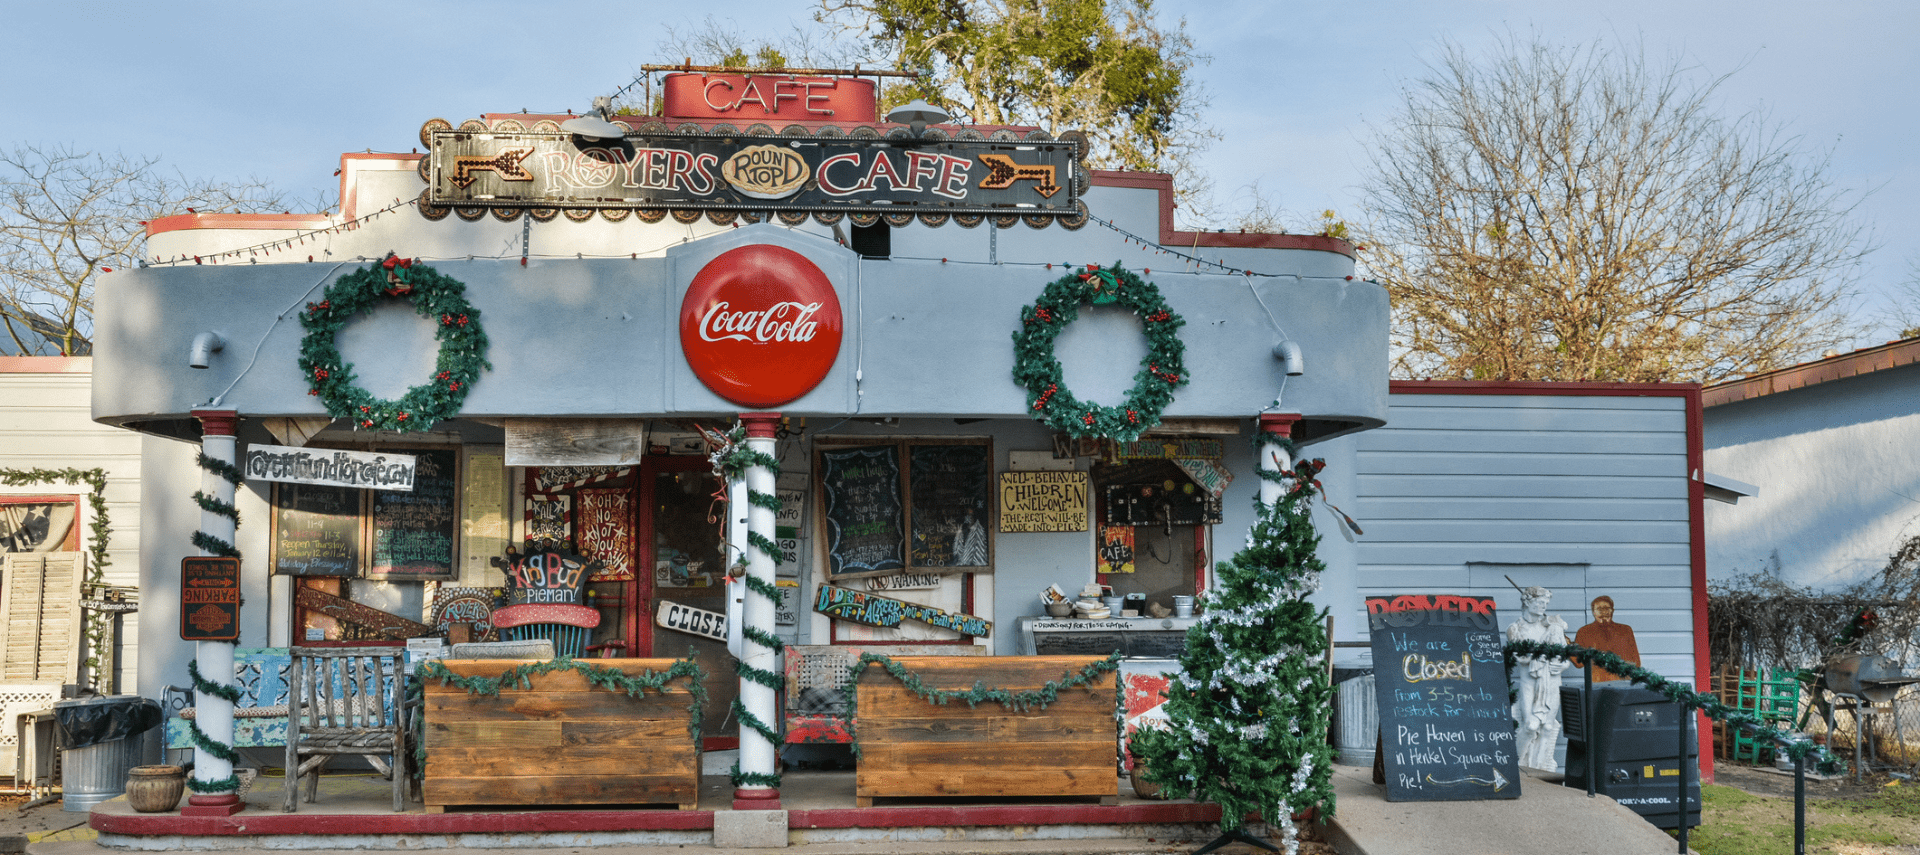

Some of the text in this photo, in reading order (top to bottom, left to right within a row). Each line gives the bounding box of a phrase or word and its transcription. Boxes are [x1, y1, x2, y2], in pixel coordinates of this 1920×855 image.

[703, 79, 834, 116] CAFE
[540, 147, 973, 199] ROYERS CAFE
[734, 149, 803, 186] ROUND
[750, 166, 784, 187] TOP
[699, 301, 823, 342] Coca-Cola
[1001, 472, 1030, 484] WELL
[1034, 471, 1086, 484] BEHAVED
[597, 493, 612, 508] OH
[776, 493, 803, 502] AVEN
[1004, 483, 1086, 511] CHILDREN
[1018, 496, 1067, 512] WELCOME
[540, 503, 556, 520] ALL
[596, 508, 611, 524] NO
[1003, 512, 1084, 523] THE REST WILL BE
[532, 522, 565, 541] SERVICES
[590, 522, 617, 540] NOT
[1003, 521, 1082, 532] MADE INTO PIES
[592, 539, 614, 555] YOU
[781, 539, 797, 550] GO
[1105, 535, 1124, 547] CAT
[1100, 545, 1129, 560] CAFE
[547, 552, 587, 588] Bud
[891, 573, 940, 588] WHINING
[185, 589, 236, 602] PARKING
[445, 600, 488, 620] ROYERS
[841, 606, 851, 618] IF
[901, 606, 918, 617] YOU
[1365, 595, 1496, 631] ROYERS
[668, 605, 727, 639] CLOSE
[1391, 632, 1451, 652] We are
[1402, 651, 1473, 683] Closed
[1478, 687, 1493, 701] to
[1393, 703, 1440, 717] restock
[1397, 723, 1513, 746] Pie Haven is open
[1395, 746, 1510, 770] in Henkel Square for
[1398, 769, 1423, 790] Pie!
